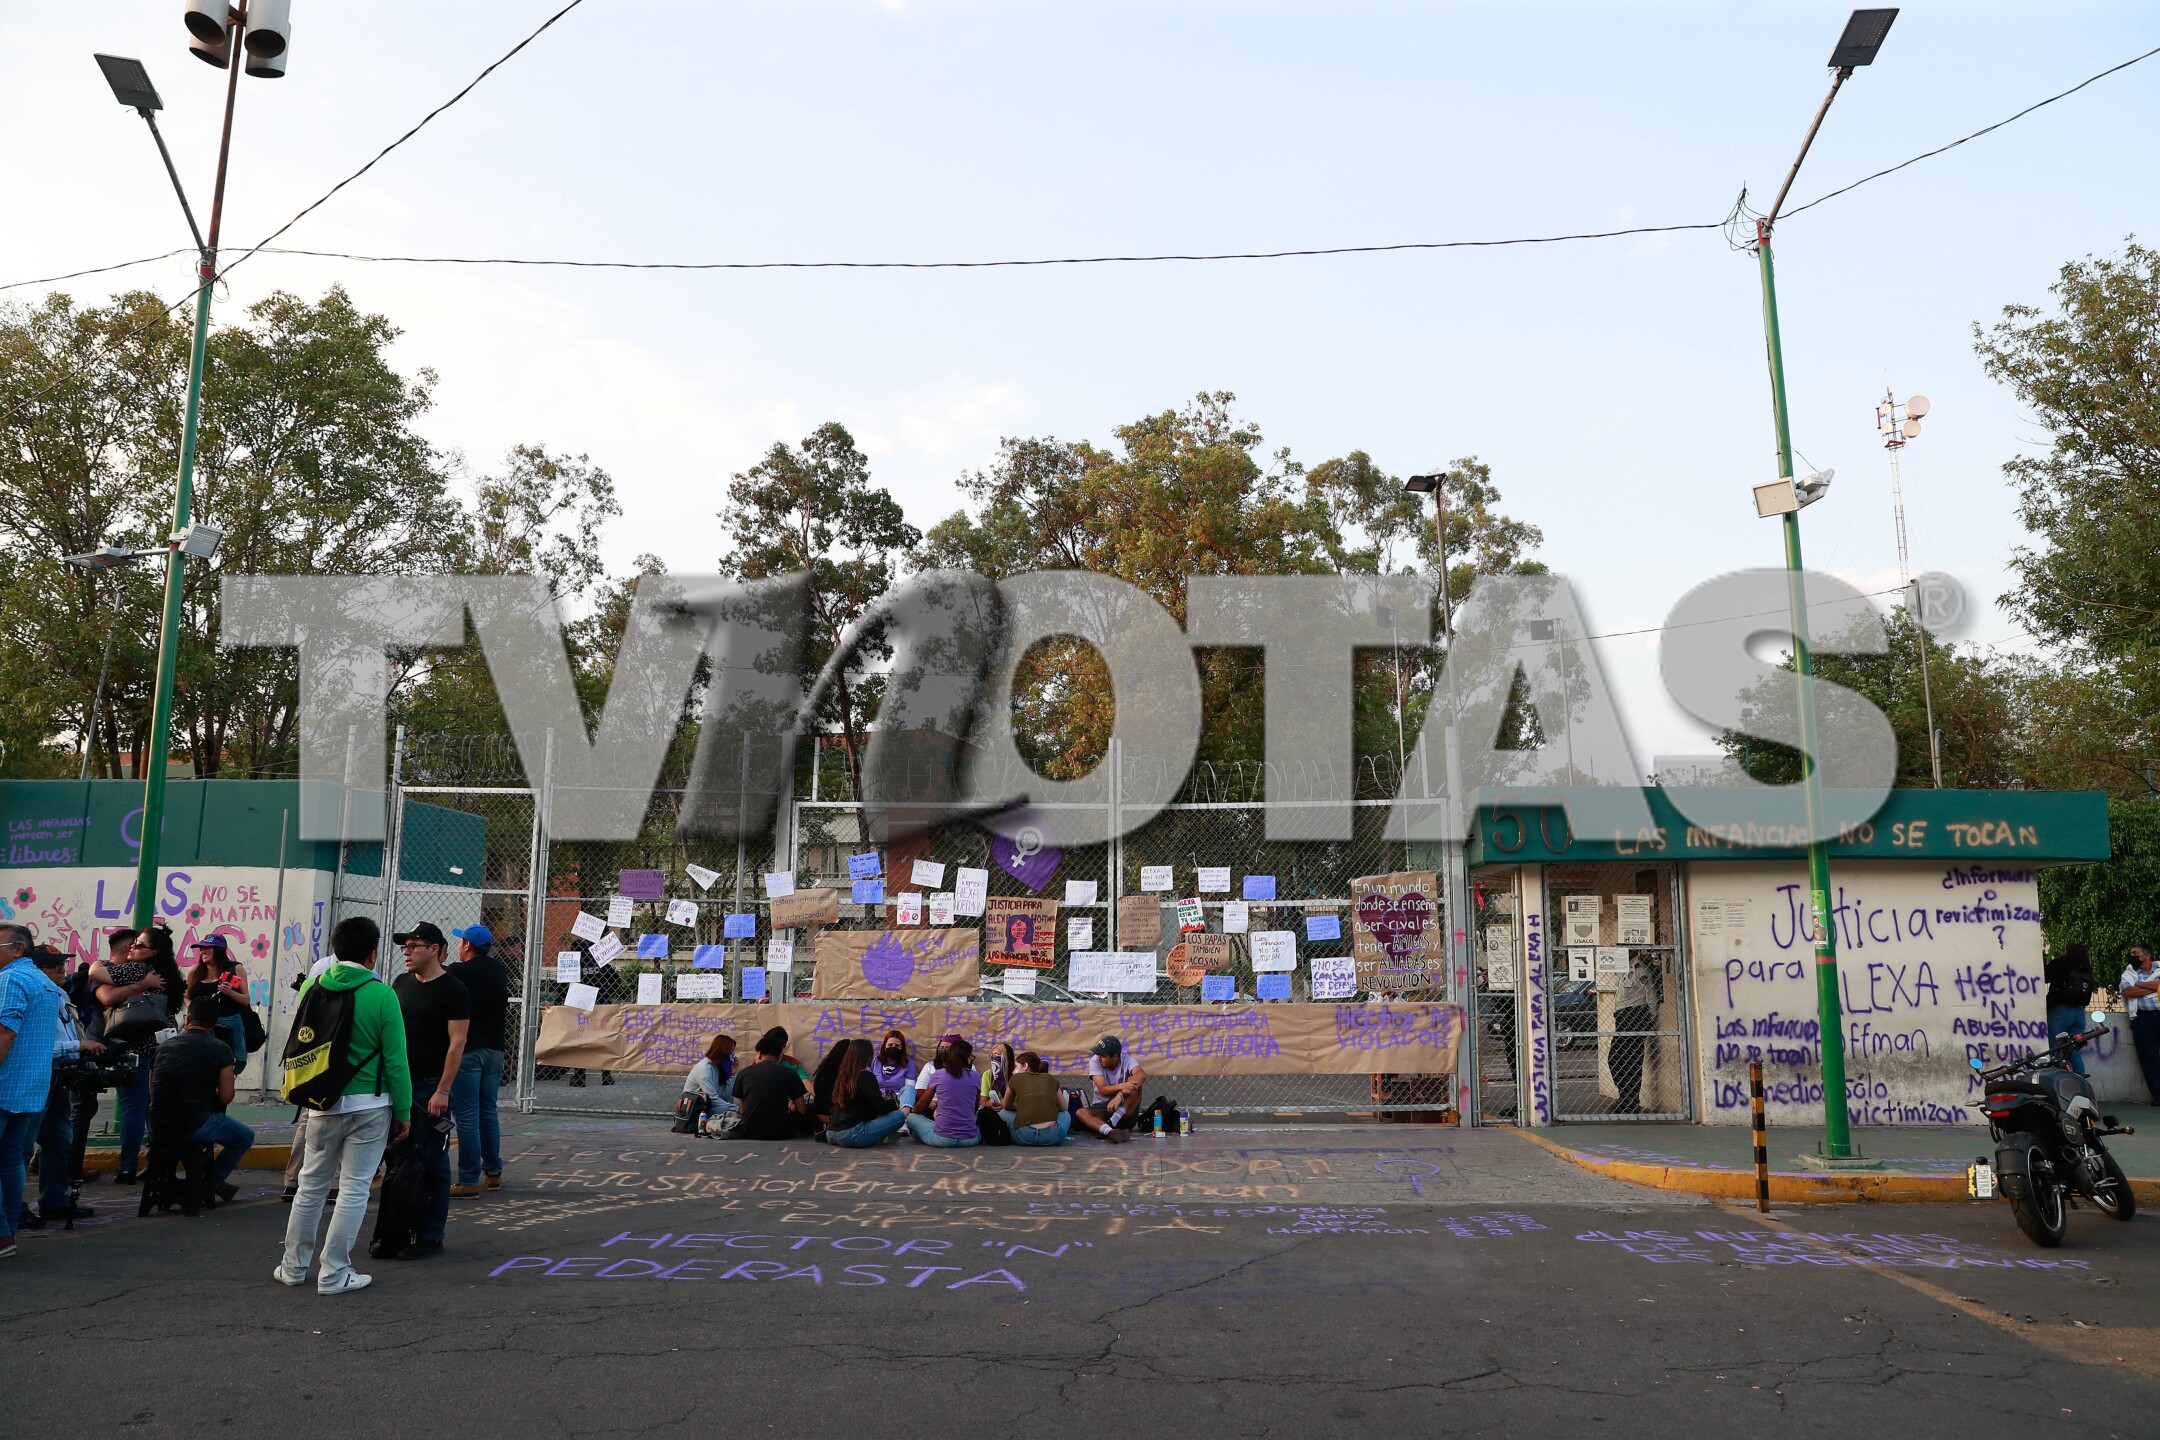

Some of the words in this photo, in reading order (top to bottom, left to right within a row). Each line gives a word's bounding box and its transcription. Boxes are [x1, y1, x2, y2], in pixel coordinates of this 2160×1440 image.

[8, 819, 33, 832] LAS
[1492, 793, 1575, 853] 50
[1615, 826, 1667, 855] LAS
[1839, 821, 1874, 844] NO
[1892, 821, 1928, 847] SE
[1946, 821, 2038, 847] TOCAN
[201, 885, 228, 904] NO
[237, 885, 259, 903] SE
[1355, 879, 1370, 894] En
[1371, 883, 1387, 894] un
[1389, 878, 1431, 894] mundo
[988, 900, 1021, 911] JUSTICIA
[1023, 899, 1042, 909] PARA
[1178, 898, 1196, 907] ALEXA
[1354, 896, 1386, 912] donde
[1386, 899, 1400, 912] se
[209, 904, 278, 924] MATAN
[1772, 884, 1933, 949] Juticia
[1363, 921, 1384, 932] ser
[1188, 934, 1202, 945] LOS
[1356, 939, 1391, 954] tener
[1392, 934, 1430, 950] AMIGAS
[1433, 940, 1440, 951] y
[988, 950, 999, 960] LAS
[1000, 952, 1030, 961] INFANCIAS
[1188, 957, 1219, 966] ACOSAN
[1357, 960, 1377, 973] ser
[1380, 954, 1426, 970] ALIADAS
[1428, 957, 1440, 970] es
[1527, 932, 1546, 991] ALEXA
[1313, 972, 1354, 981] CANSAN
[1313, 982, 1325, 991] DE
[1725, 958, 1805, 1010] para
[1955, 961, 2041, 1002] Héctor
[1817, 961, 1940, 1014] LEXA
[624, 1008, 655, 1030] LOS
[812, 1004, 918, 1036] ALEXA
[944, 1007, 991, 1030] LOS
[1119, 1010, 1183, 1034] VERGA
[1531, 993, 1545, 1031] PARA
[1716, 1015, 1747, 1041] Las
[1952, 1017, 2048, 1040] ABUSADOR
[1136, 1036, 1164, 1057] LA
[1337, 1028, 1449, 1051] VIOLADOR
[1965, 1043, 1991, 1063] DE
[1533, 1036, 1549, 1124] JUSTICIA
[1714, 1078, 1750, 1109] Los
[852, 1203, 994, 1214] FALTA
[1694, 1231, 1961, 1244] INFANCIAS
[1639, 1253, 1715, 1264] ES
[487, 1257, 1028, 1292] PEDERASTA
